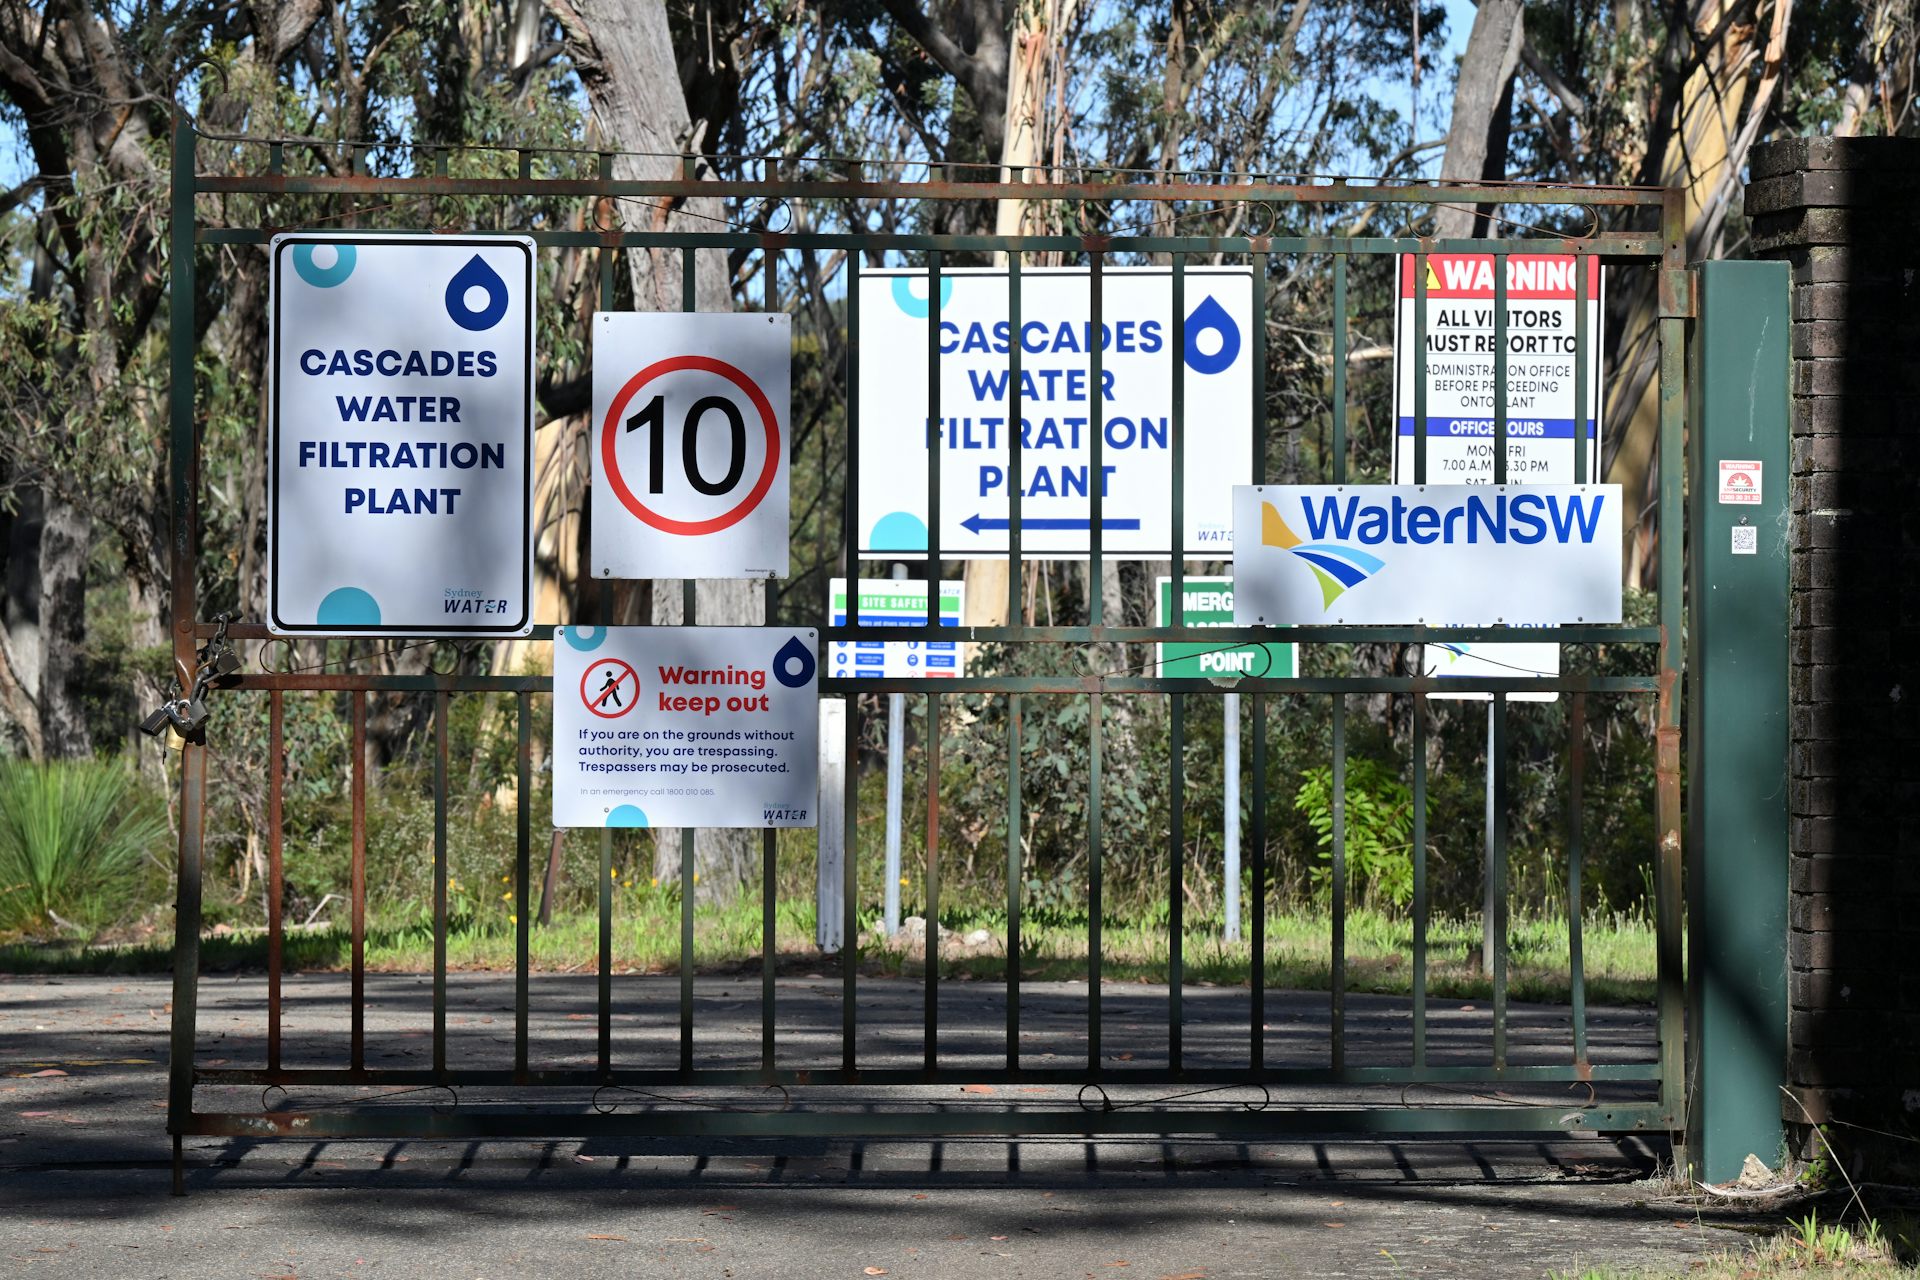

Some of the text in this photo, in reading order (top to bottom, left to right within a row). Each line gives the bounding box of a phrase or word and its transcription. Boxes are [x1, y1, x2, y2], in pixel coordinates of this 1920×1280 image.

[1437, 310, 1562, 328] ALL VIITORS
[939, 320, 1163, 354] CASCADES
[1475, 335, 1548, 353] REORT
[1553, 336, 1576, 353] TO
[300, 349, 497, 377] CASCADES
[1426, 364, 1570, 377] ADMINISTRAON OFFICE
[968, 369, 1116, 401] WATER
[1435, 380, 1559, 393] BEFORE PRCEEDING
[336, 396, 461, 422] WATER
[1461, 396, 1536, 409] ONTO LANT
[925, 417, 1168, 450] ILTRATON
[1450, 420, 1545, 436] OFFICE OURS
[626, 396, 746, 496] 10
[1467, 445, 1526, 457] MON FRI
[300, 441, 504, 469] FILTRATION
[1443, 459, 1466, 471] 7.00
[1531, 460, 1549, 472] PM
[345, 488, 461, 514] PLANT
[1301, 494, 1605, 545] WaterNSW
[1198, 530, 1234, 541] WATE
[444, 588, 482, 599] Sydney
[444, 599, 507, 614] WATER
[862, 596, 886, 608] SITE
[1199, 651, 1255, 673] POINT
[658, 665, 766, 690] Warning
[659, 692, 769, 716] keep out
[579, 729, 794, 743] If you are on the grounds without
[579, 745, 778, 759] authority, you are trespassing.
[579, 761, 790, 775] Trespassers may be prosecuted.
[603, 788, 648, 797] emergency
[667, 788, 684, 796] 1800
[686, 788, 698, 796] 010
[763, 809, 807, 820] WATER
